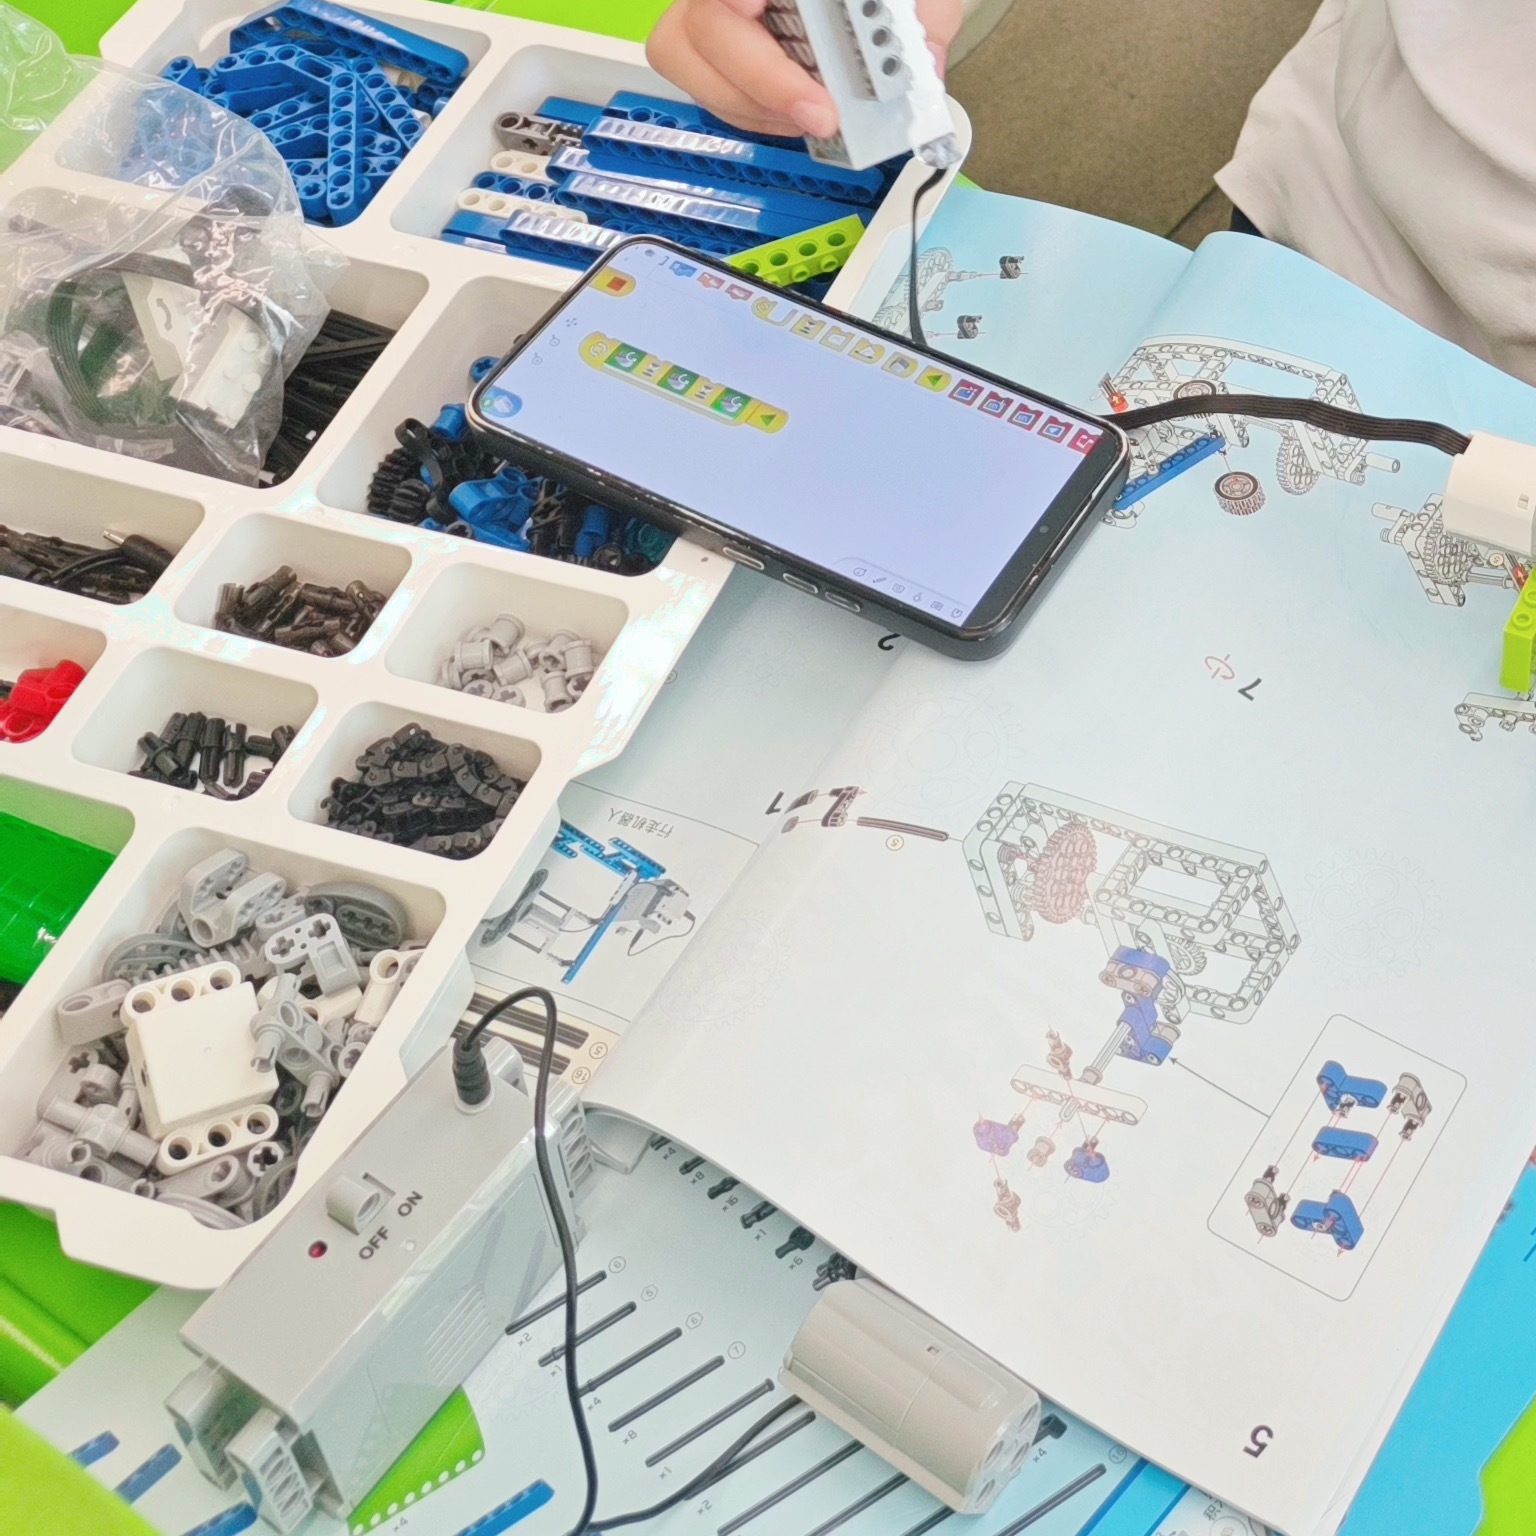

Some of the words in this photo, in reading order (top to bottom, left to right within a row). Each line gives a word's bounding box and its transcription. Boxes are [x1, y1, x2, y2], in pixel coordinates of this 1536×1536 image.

[1237, 676, 1263, 702] 7
[607, 807, 675, 839] 行走机器人
[397, 1190, 424, 1217] ON
[358, 1225, 389, 1260] OFF
[1243, 1424, 1274, 1459] 5
